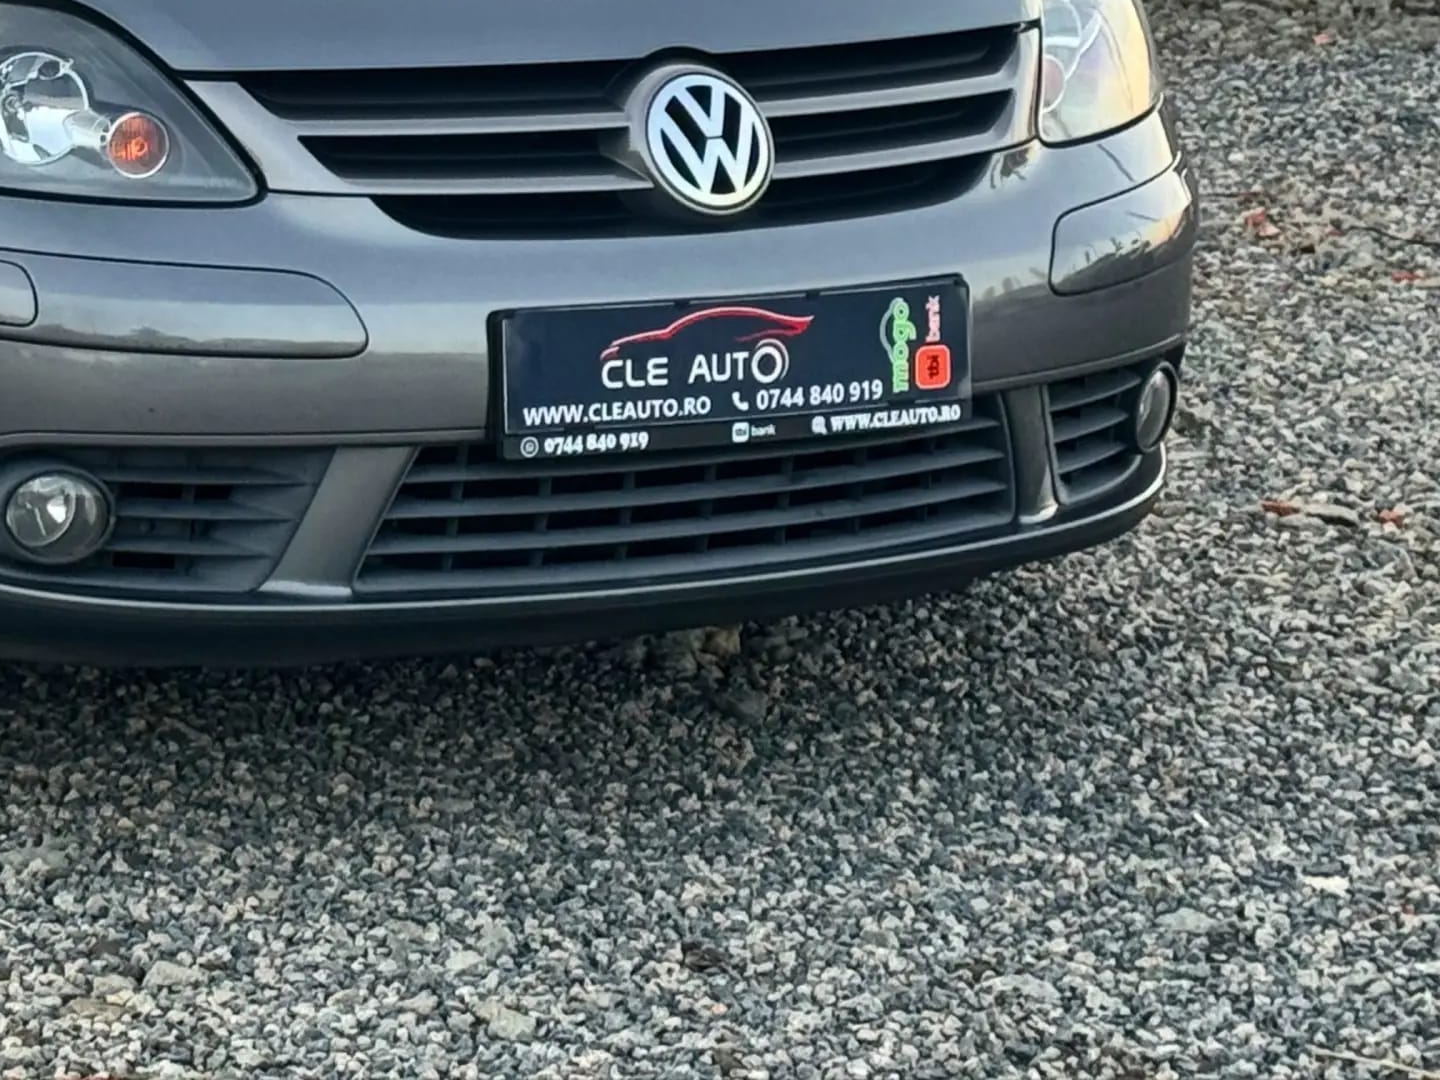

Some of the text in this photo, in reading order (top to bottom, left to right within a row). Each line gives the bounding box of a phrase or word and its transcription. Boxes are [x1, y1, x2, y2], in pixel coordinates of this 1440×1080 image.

[648, 74, 769, 207] VW
[601, 344, 784, 388] CLE AUTO
[523, 395, 711, 426] WWW.CLEAUTO.RO
[756, 378, 884, 411] 0744 840 919
[544, 431, 649, 455] 0744 840 919
